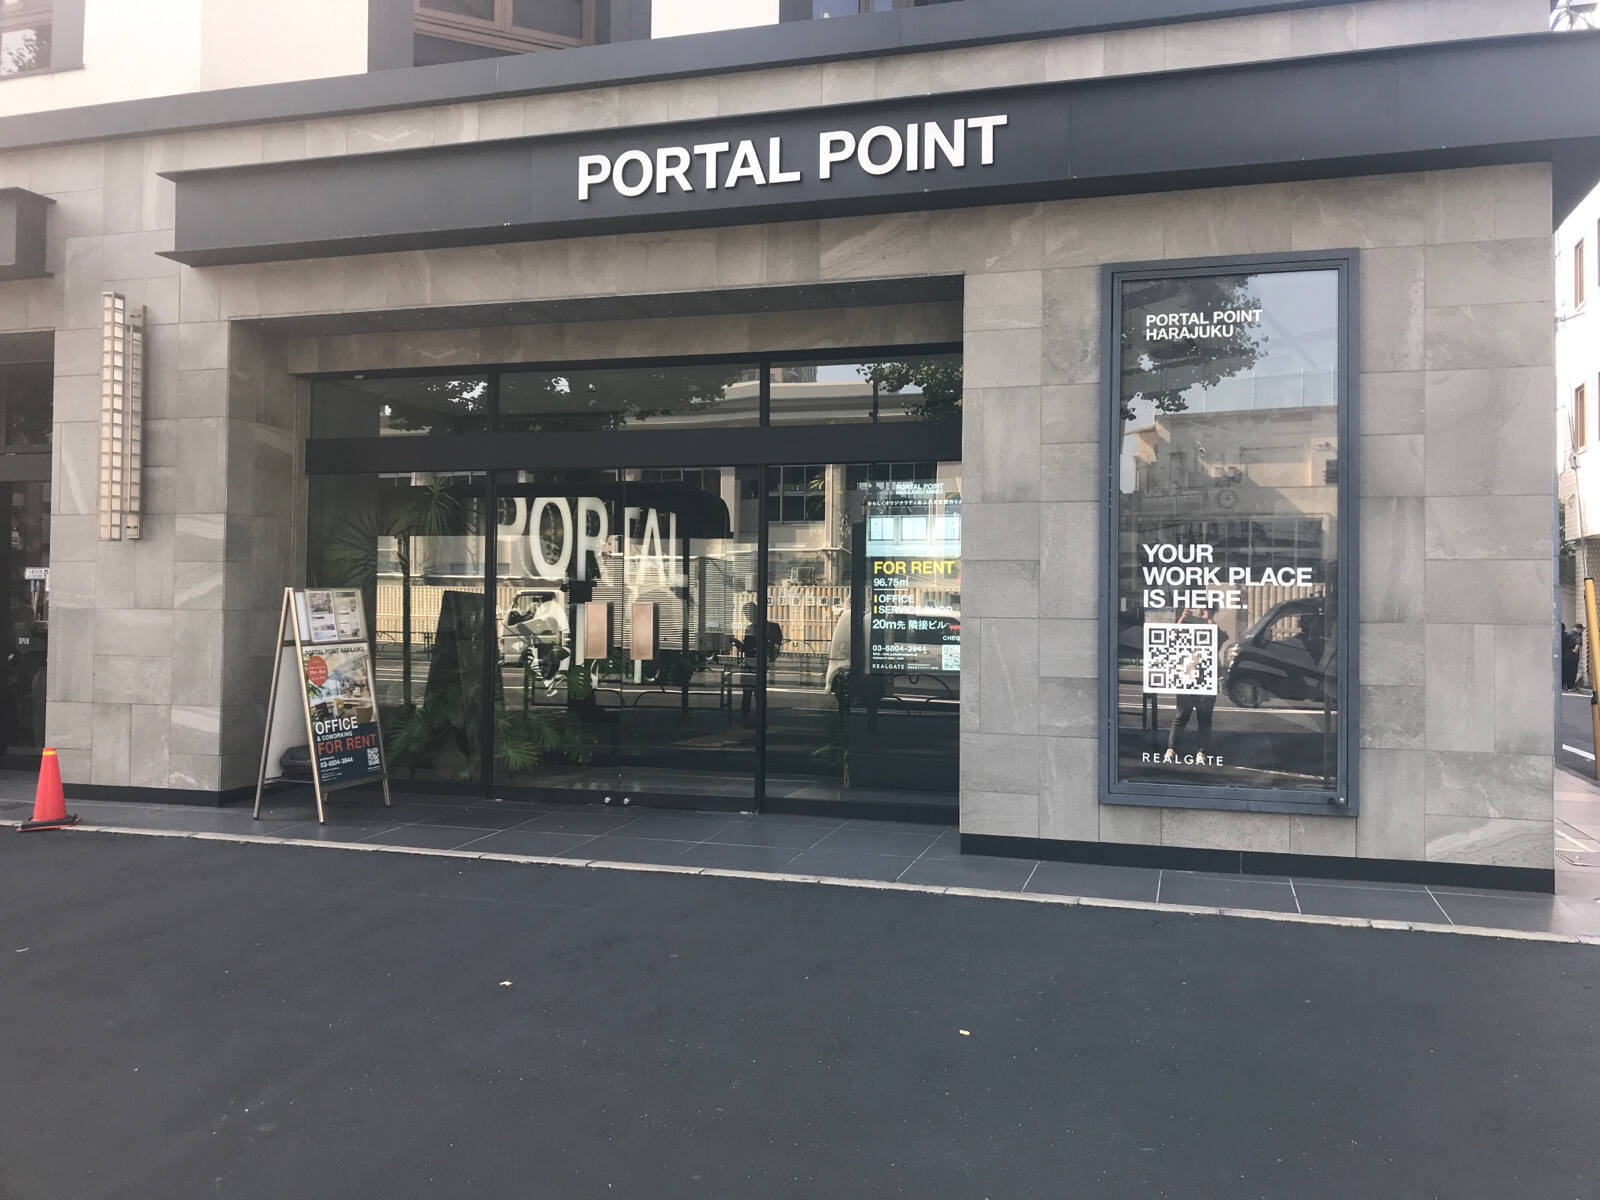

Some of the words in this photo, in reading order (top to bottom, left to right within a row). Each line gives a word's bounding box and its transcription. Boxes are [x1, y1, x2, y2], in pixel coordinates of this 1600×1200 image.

[578, 136, 801, 201] PORTAL
[819, 114, 1008, 180] POINT
[1146, 312, 1209, 327] PORTAL
[1213, 309, 1263, 325] POINT
[1146, 325, 1235, 341] HARAJUKU
[1143, 543, 1213, 563] YOUR
[874, 561, 906, 574] FOR
[911, 561, 955, 574] RENT
[1143, 567, 1222, 586] WORK
[1229, 567, 1313, 587] PLACE
[878, 594, 915, 603] OFFICE
[1144, 589, 1166, 608] IS
[1173, 590, 1248, 609] HERE.
[878, 605, 921, 614] SERVICE
[924, 605, 953, 614] SHOP
[872, 619, 906, 630] 20m先
[908, 619, 947, 631] 隣接ビル
[872, 644, 927, 652] 03-6804-3944
[315, 716, 359, 735] OFFICE
[321, 730, 353, 741] COWORKING
[317, 739, 343, 756] FOR
[346, 733, 376, 751] RENT
[1142, 752, 1224, 766] REALGATE
